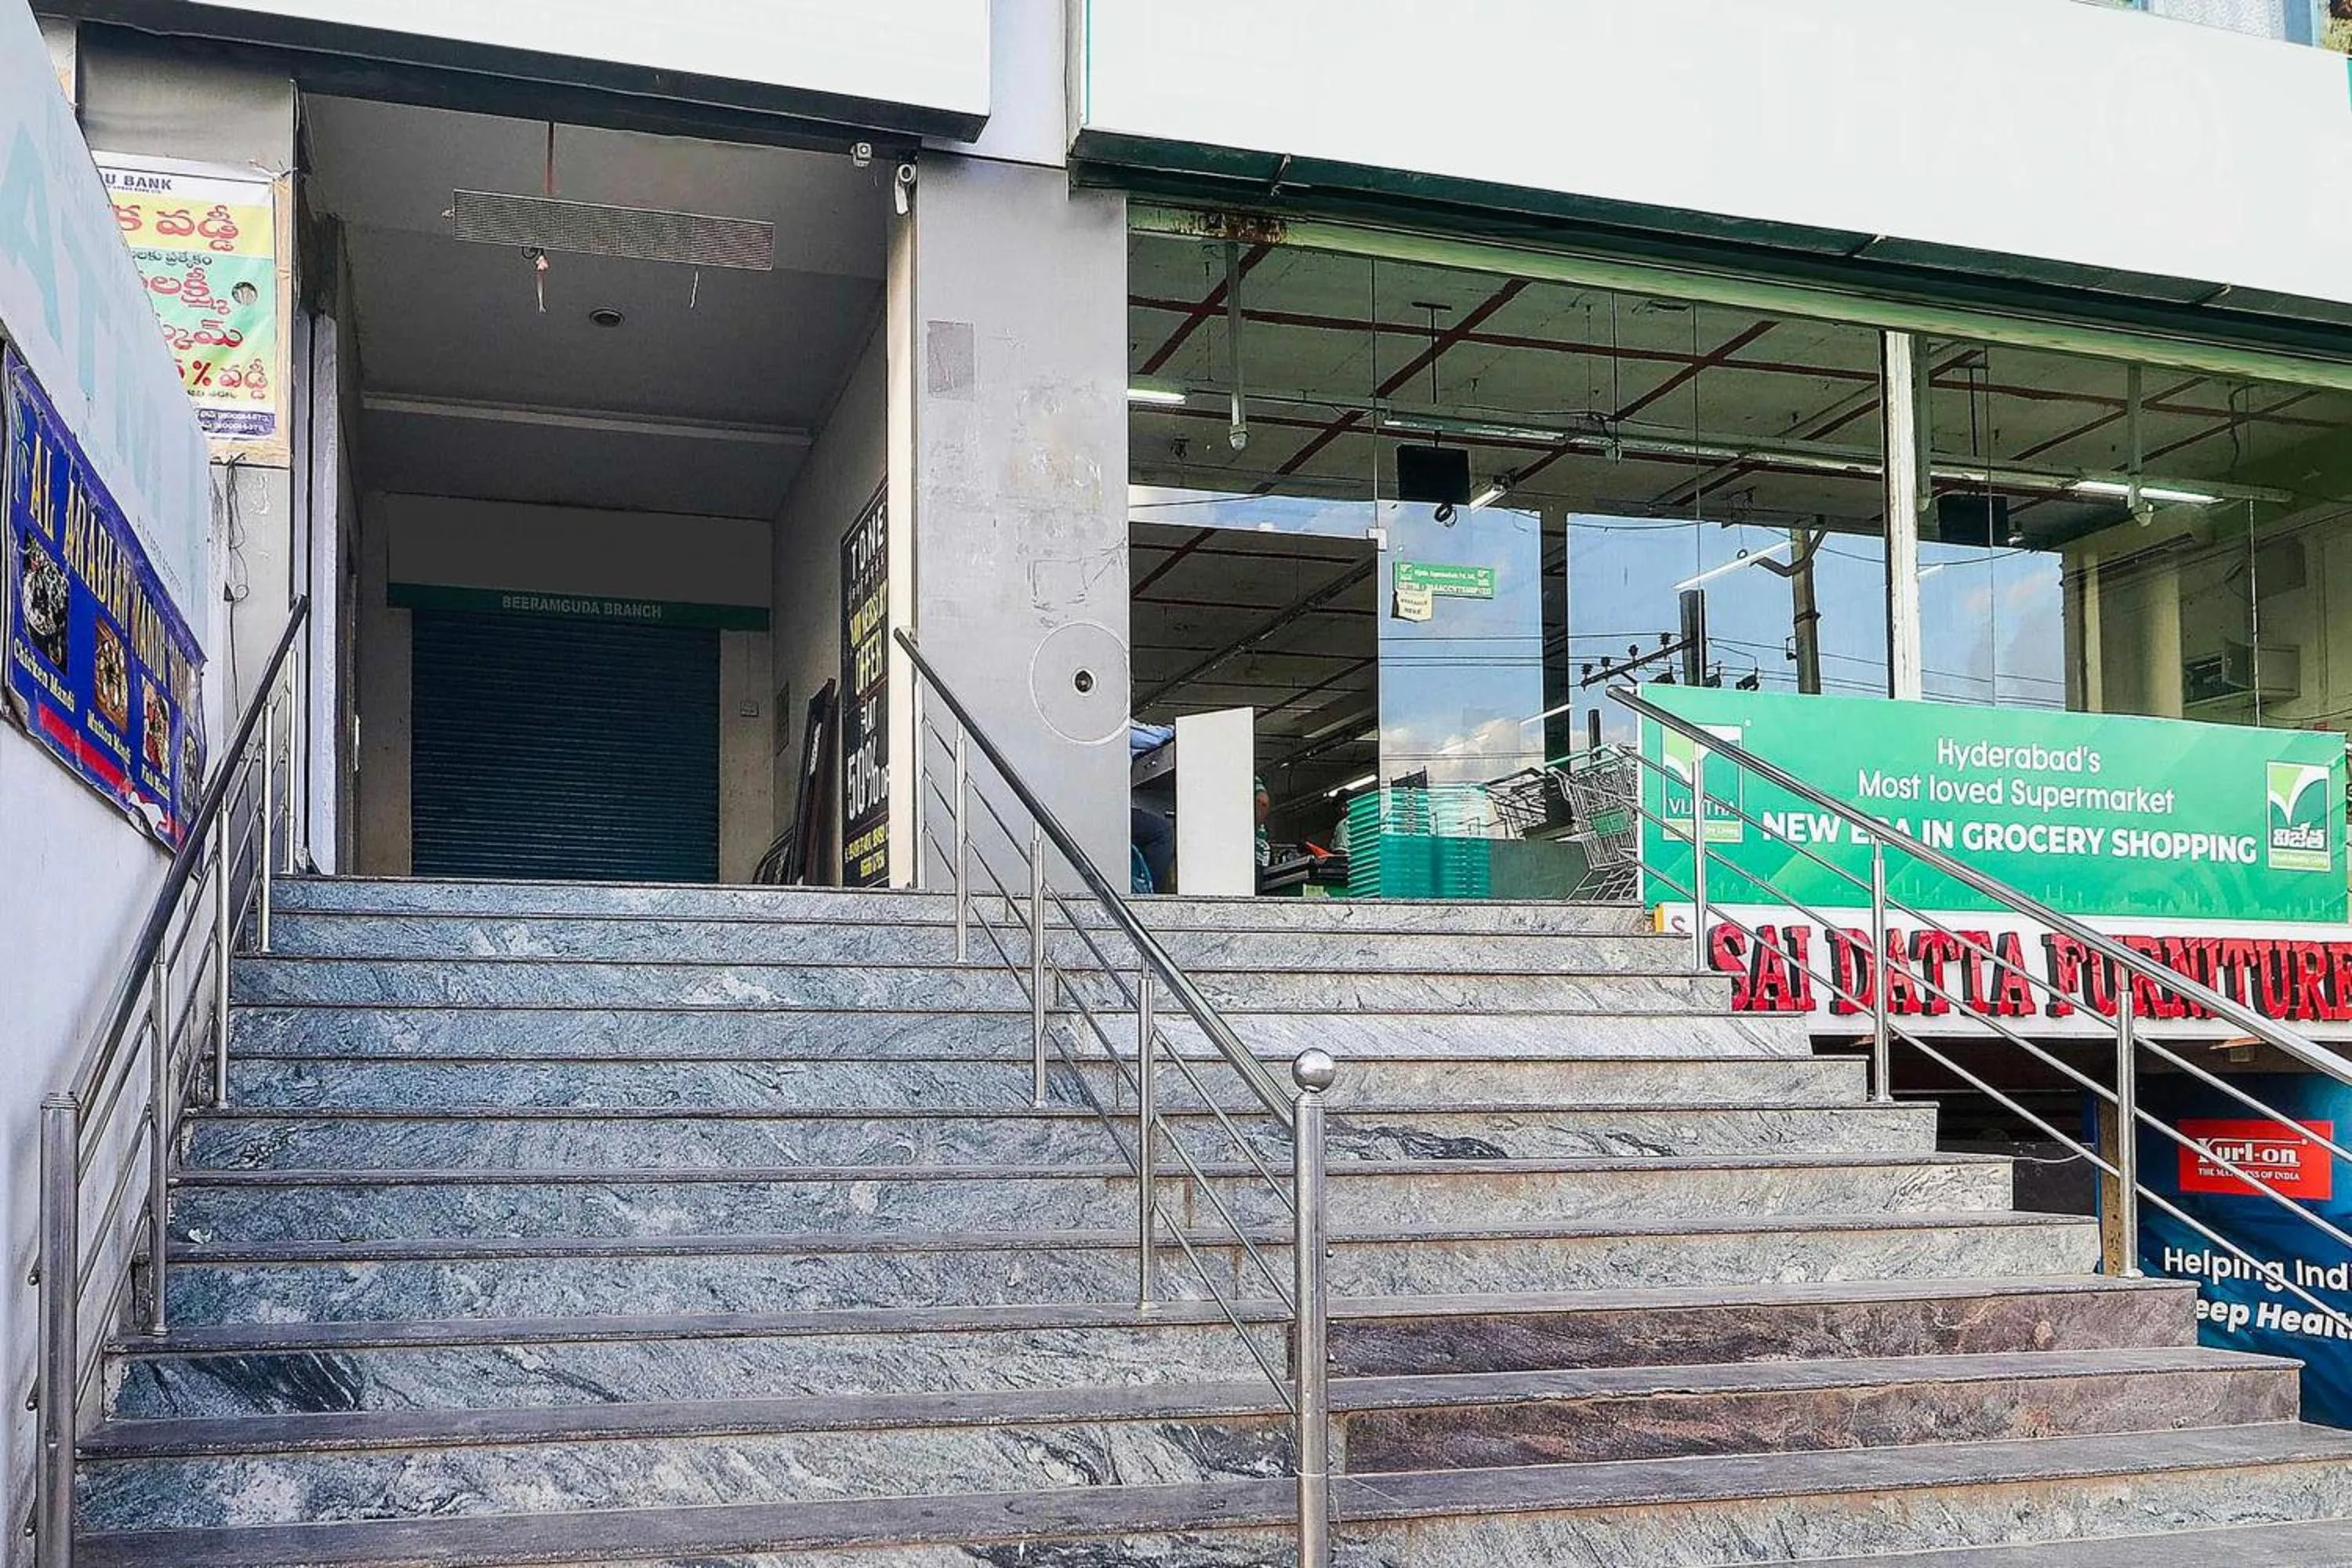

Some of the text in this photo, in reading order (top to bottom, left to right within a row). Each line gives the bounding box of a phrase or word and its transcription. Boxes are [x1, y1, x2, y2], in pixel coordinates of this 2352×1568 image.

[123, 174, 172, 191] BANK
[30, 431, 55, 542] AL
[62, 472, 129, 638] ARABIAN
[851, 505, 885, 581] TONE
[502, 595, 662, 619] BEERAMGUDA BRANCH
[13, 637, 75, 713] Chicken Mandi
[848, 734, 880, 821] 50%
[1936, 737, 2101, 773] Hyderabad's
[1668, 797, 1736, 816] VIJTHA
[1858, 769, 2175, 815] Most loved Supermarket
[1762, 811, 1842, 844] NEW
[1922, 818, 1954, 850] IN
[1962, 822, 2106, 856] GROCERY
[2111, 827, 2258, 863] SHOPPING
[1706, 920, 1817, 1012] SAI
[1825, 927, 2037, 1018] DATTA
[2274, 1171, 2300, 1181] INDIA
[2164, 1246, 2352, 1292] Helping Ind
